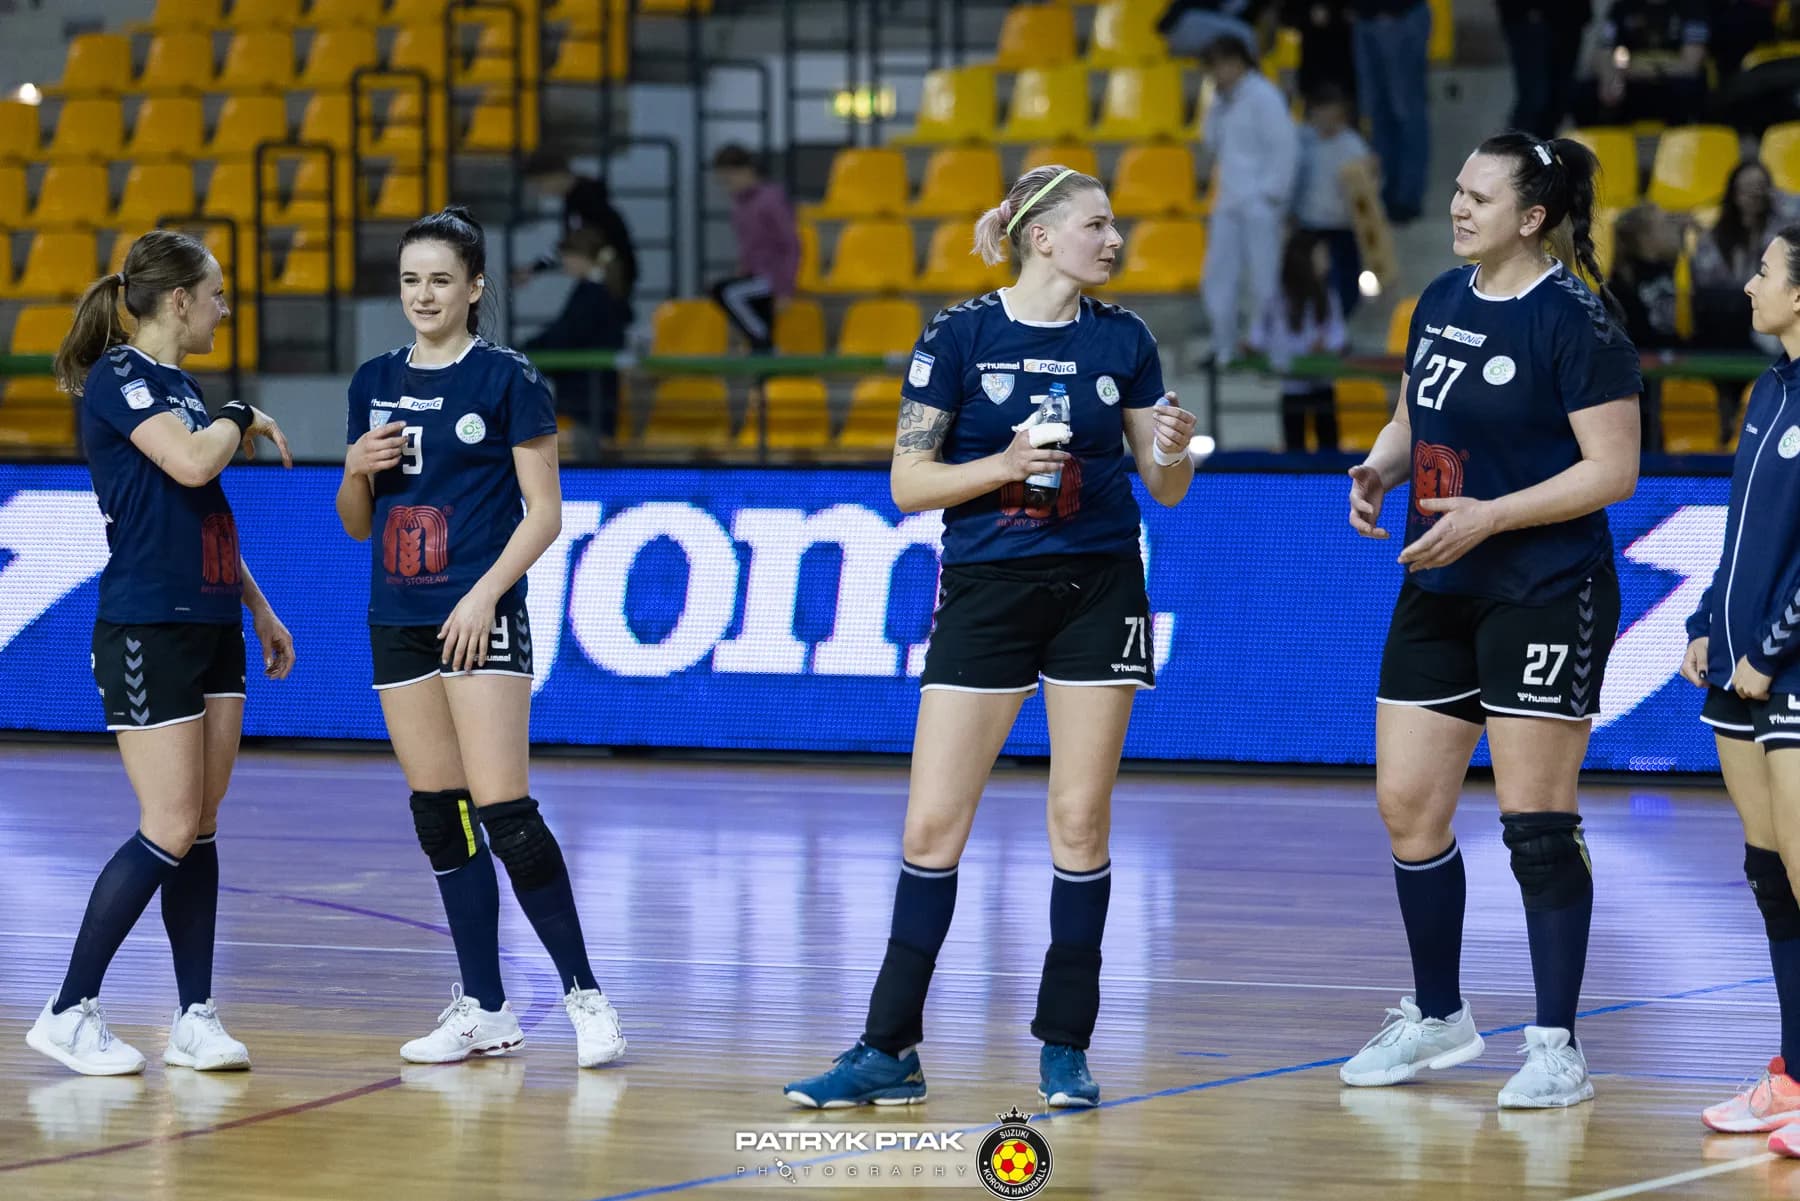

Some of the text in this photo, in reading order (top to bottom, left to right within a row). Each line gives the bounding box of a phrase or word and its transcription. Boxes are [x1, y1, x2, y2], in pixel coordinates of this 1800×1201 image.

[1040, 363, 1074, 374] PGNiG
[1417, 354, 1467, 411] 27
[401, 426, 423, 475] 9
[1122, 617, 1147, 659] 71
[1523, 643, 1569, 686] 27
